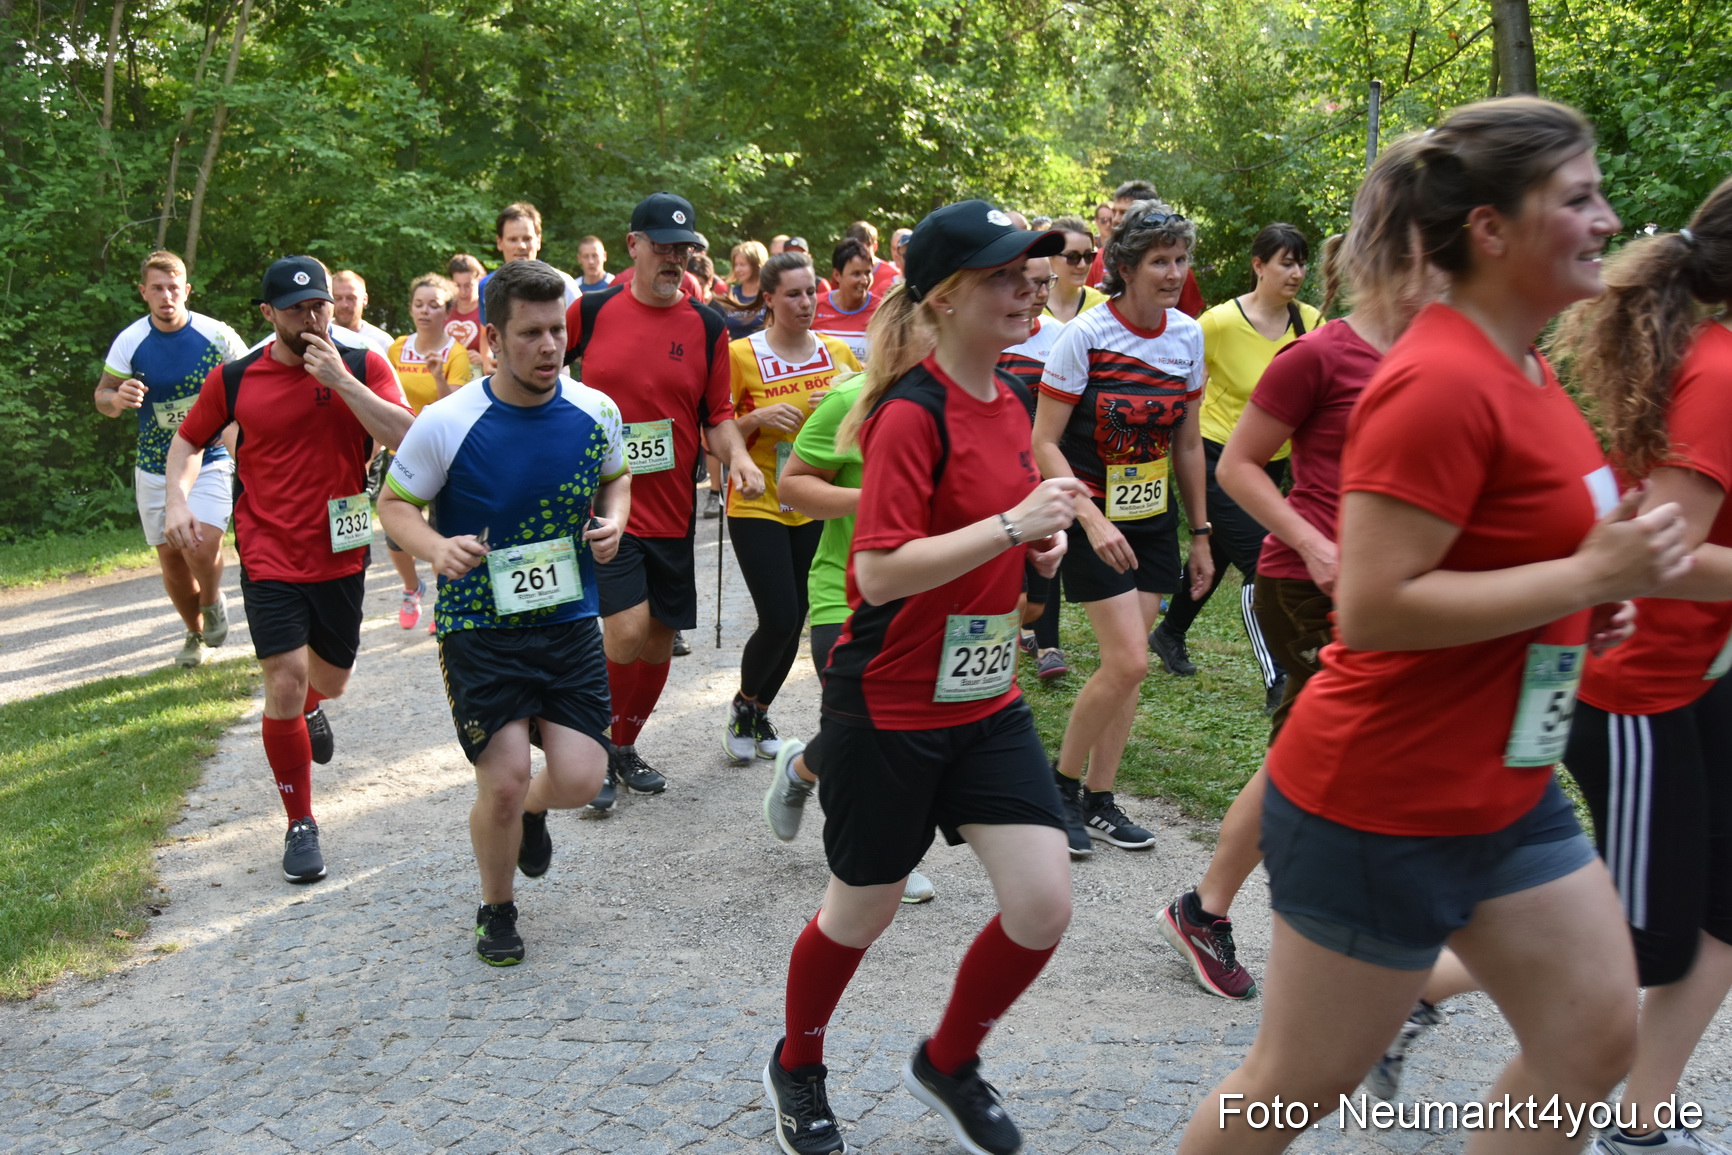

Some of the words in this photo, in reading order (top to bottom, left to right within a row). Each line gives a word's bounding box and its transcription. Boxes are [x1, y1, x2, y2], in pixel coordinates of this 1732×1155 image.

[763, 382, 801, 398] MAX
[804, 375, 835, 391] BÖG
[626, 438, 666, 460] 355
[1115, 479, 1162, 505] 2256
[335, 511, 369, 537] 2332
[511, 563, 558, 594] 261
[950, 641, 1013, 678] 2326
